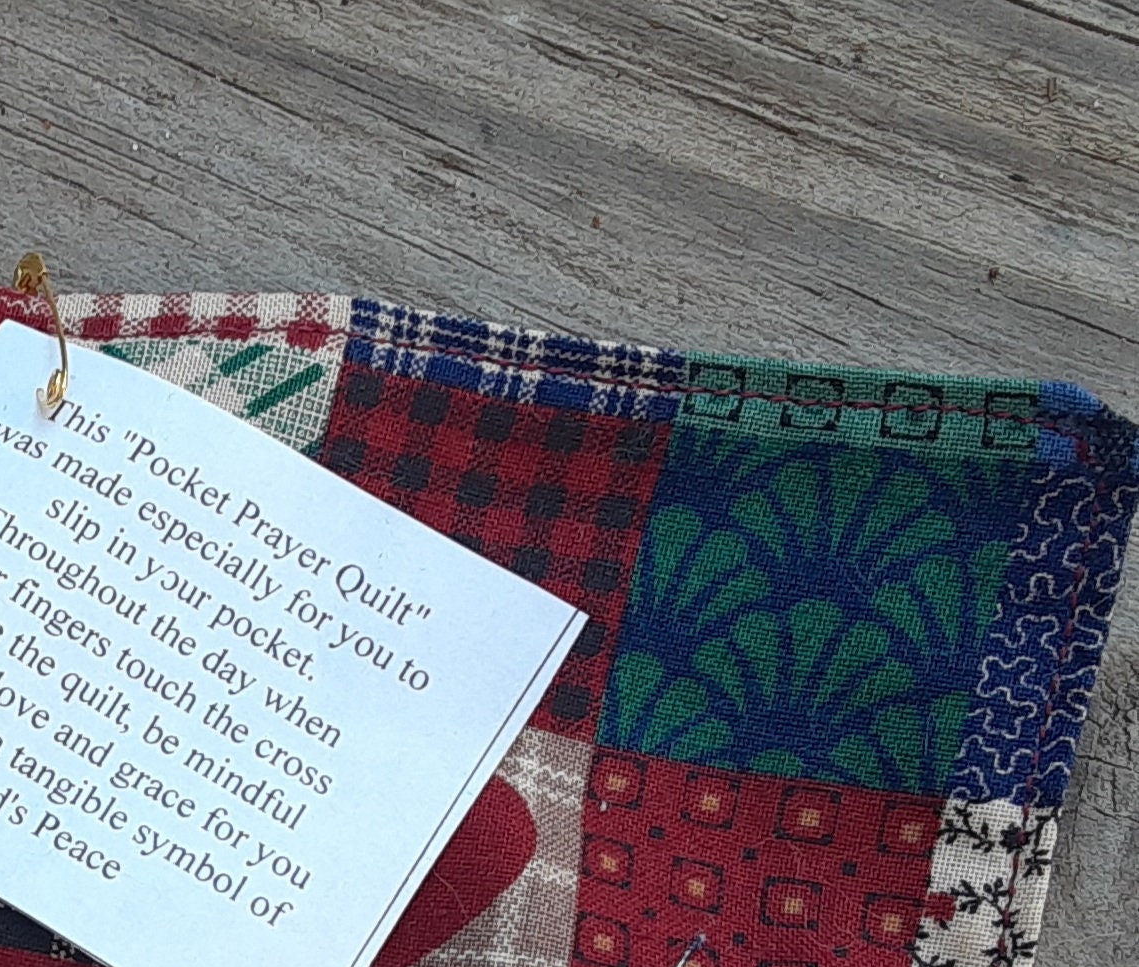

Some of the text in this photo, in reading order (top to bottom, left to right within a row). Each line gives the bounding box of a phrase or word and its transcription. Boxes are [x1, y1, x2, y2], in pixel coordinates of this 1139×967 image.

[45, 499, 314, 682] slip in your pocket.
[47, 398, 432, 626] This "Pocket Prayer Quilt"
[51, 451, 133, 507] made
[137, 501, 283, 602] especially
[283, 589, 334, 632] for
[328, 622, 394, 671] you
[398, 658, 430, 691] to
[8, 633, 56, 677] the
[60, 672, 132, 734] quilt,
[142, 714, 180, 755] be
[182, 748, 307, 831] mindful
[9, 578, 112, 658] fingers
[115, 647, 197, 714] touch
[202, 702, 249, 744] the
[254, 739, 333, 795] cross
[150, 614, 197, 657] the
[201, 648, 257, 696] day
[264, 686, 341, 749] when
[9, 746, 128, 830] tangible
[131, 824, 249, 902] symbol
[250, 896, 294, 927] of
[31, 810, 121, 880] Peace
[53, 724, 115, 768] and
[109, 761, 196, 818] grace
[200, 807, 250, 850] for
[245, 841, 311, 890] you
